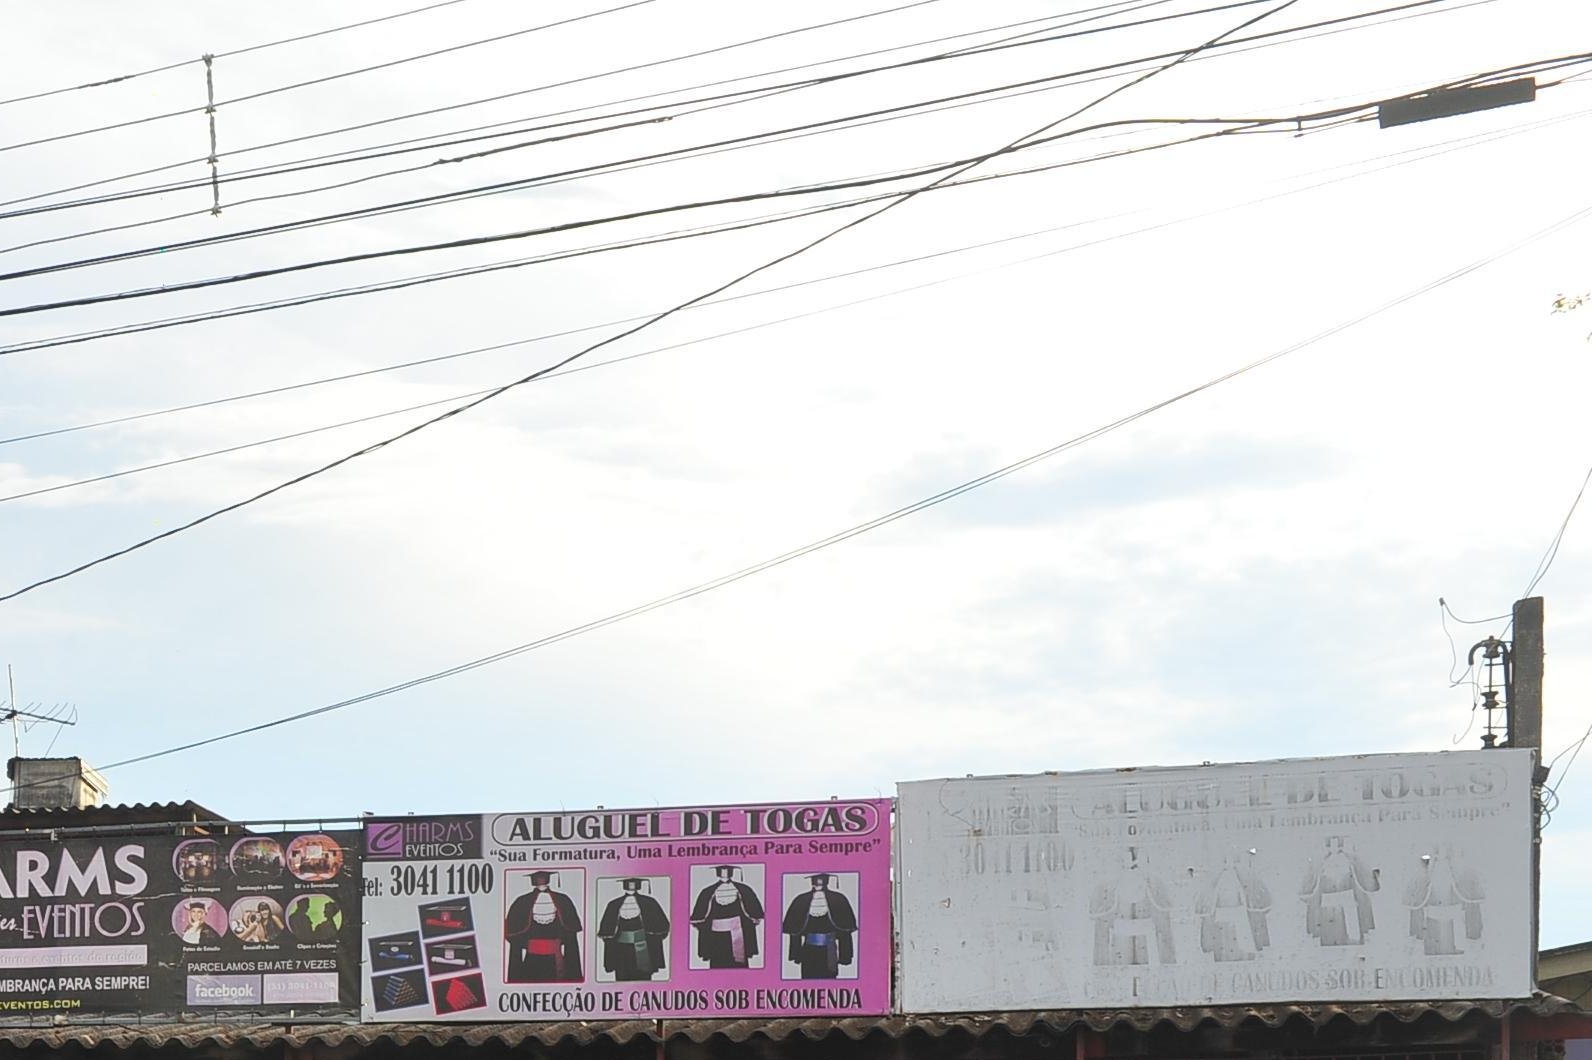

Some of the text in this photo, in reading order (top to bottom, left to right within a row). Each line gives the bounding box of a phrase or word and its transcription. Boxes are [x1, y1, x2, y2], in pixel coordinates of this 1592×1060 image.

[509, 807, 868, 841] ALUGUEL DE TOGAS
[405, 842, 464, 858] EVENTOS
[533, 847, 620, 862] Formatura,
[627, 845, 662, 859] Uma
[668, 841, 758, 858] Lembrança
[764, 840, 803, 855] Para
[390, 864, 439, 897] 3041
[446, 862, 495, 896] 1100
[22, 901, 146, 940] EVENTOS
[187, 959, 337, 972] PARCELAMOS EM ATÉ 7 VEZES
[59, 977, 93, 991] PARA
[95, 975, 150, 991] SEMPRE!
[194, 983, 254, 998] facebook
[498, 987, 863, 1017] CONFECÇÃO DE CANUDOS SOB ENCOMENDA
